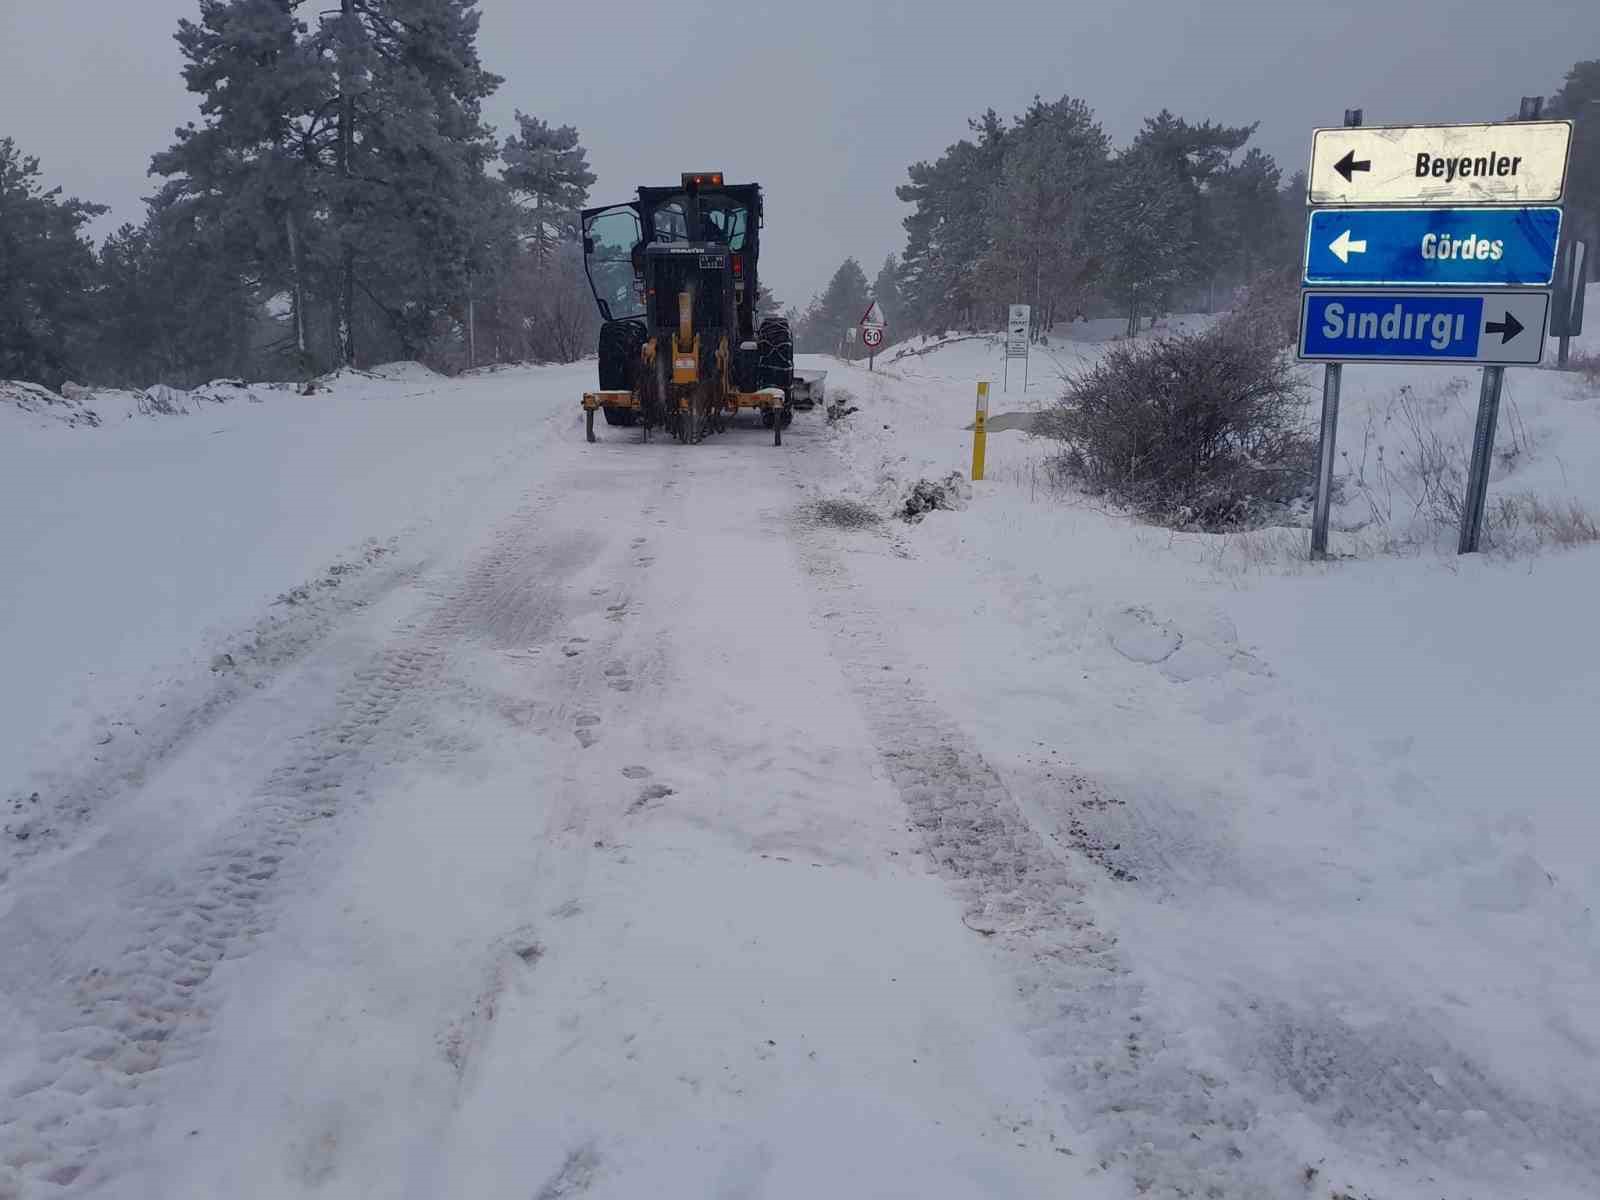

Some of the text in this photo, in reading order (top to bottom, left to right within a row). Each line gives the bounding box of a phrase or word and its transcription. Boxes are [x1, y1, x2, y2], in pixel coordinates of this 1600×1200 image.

[1415, 151, 1522, 183] Beyenler
[1421, 232, 1504, 261] Gördes
[867, 332, 879, 342] 50
[1321, 302, 1465, 350] Sındırgı
